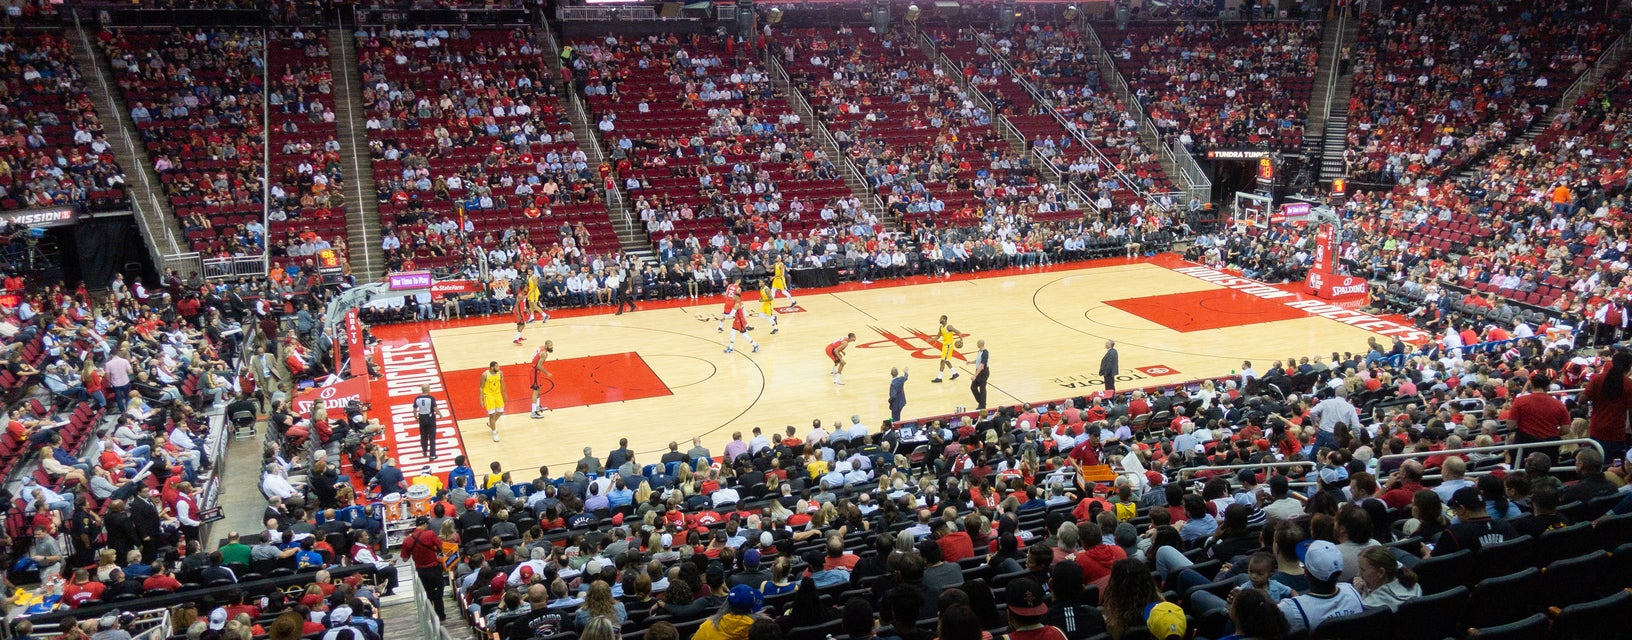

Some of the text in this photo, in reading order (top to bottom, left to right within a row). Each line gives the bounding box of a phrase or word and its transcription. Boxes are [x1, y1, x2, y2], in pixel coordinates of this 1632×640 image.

[1173, 266, 1296, 299] HOUSTON
[1332, 283, 1365, 296] SPALDING
[348, 312, 358, 344] NBA TV
[1284, 299, 1428, 342] ROCKETS
[382, 342, 443, 397] ROCKETS
[1059, 373, 1148, 389] TOOTA
[985, 496, 995, 507] 13
[1479, 534, 1504, 545] HARDEN
[528, 614, 562, 629] ORLANDO
